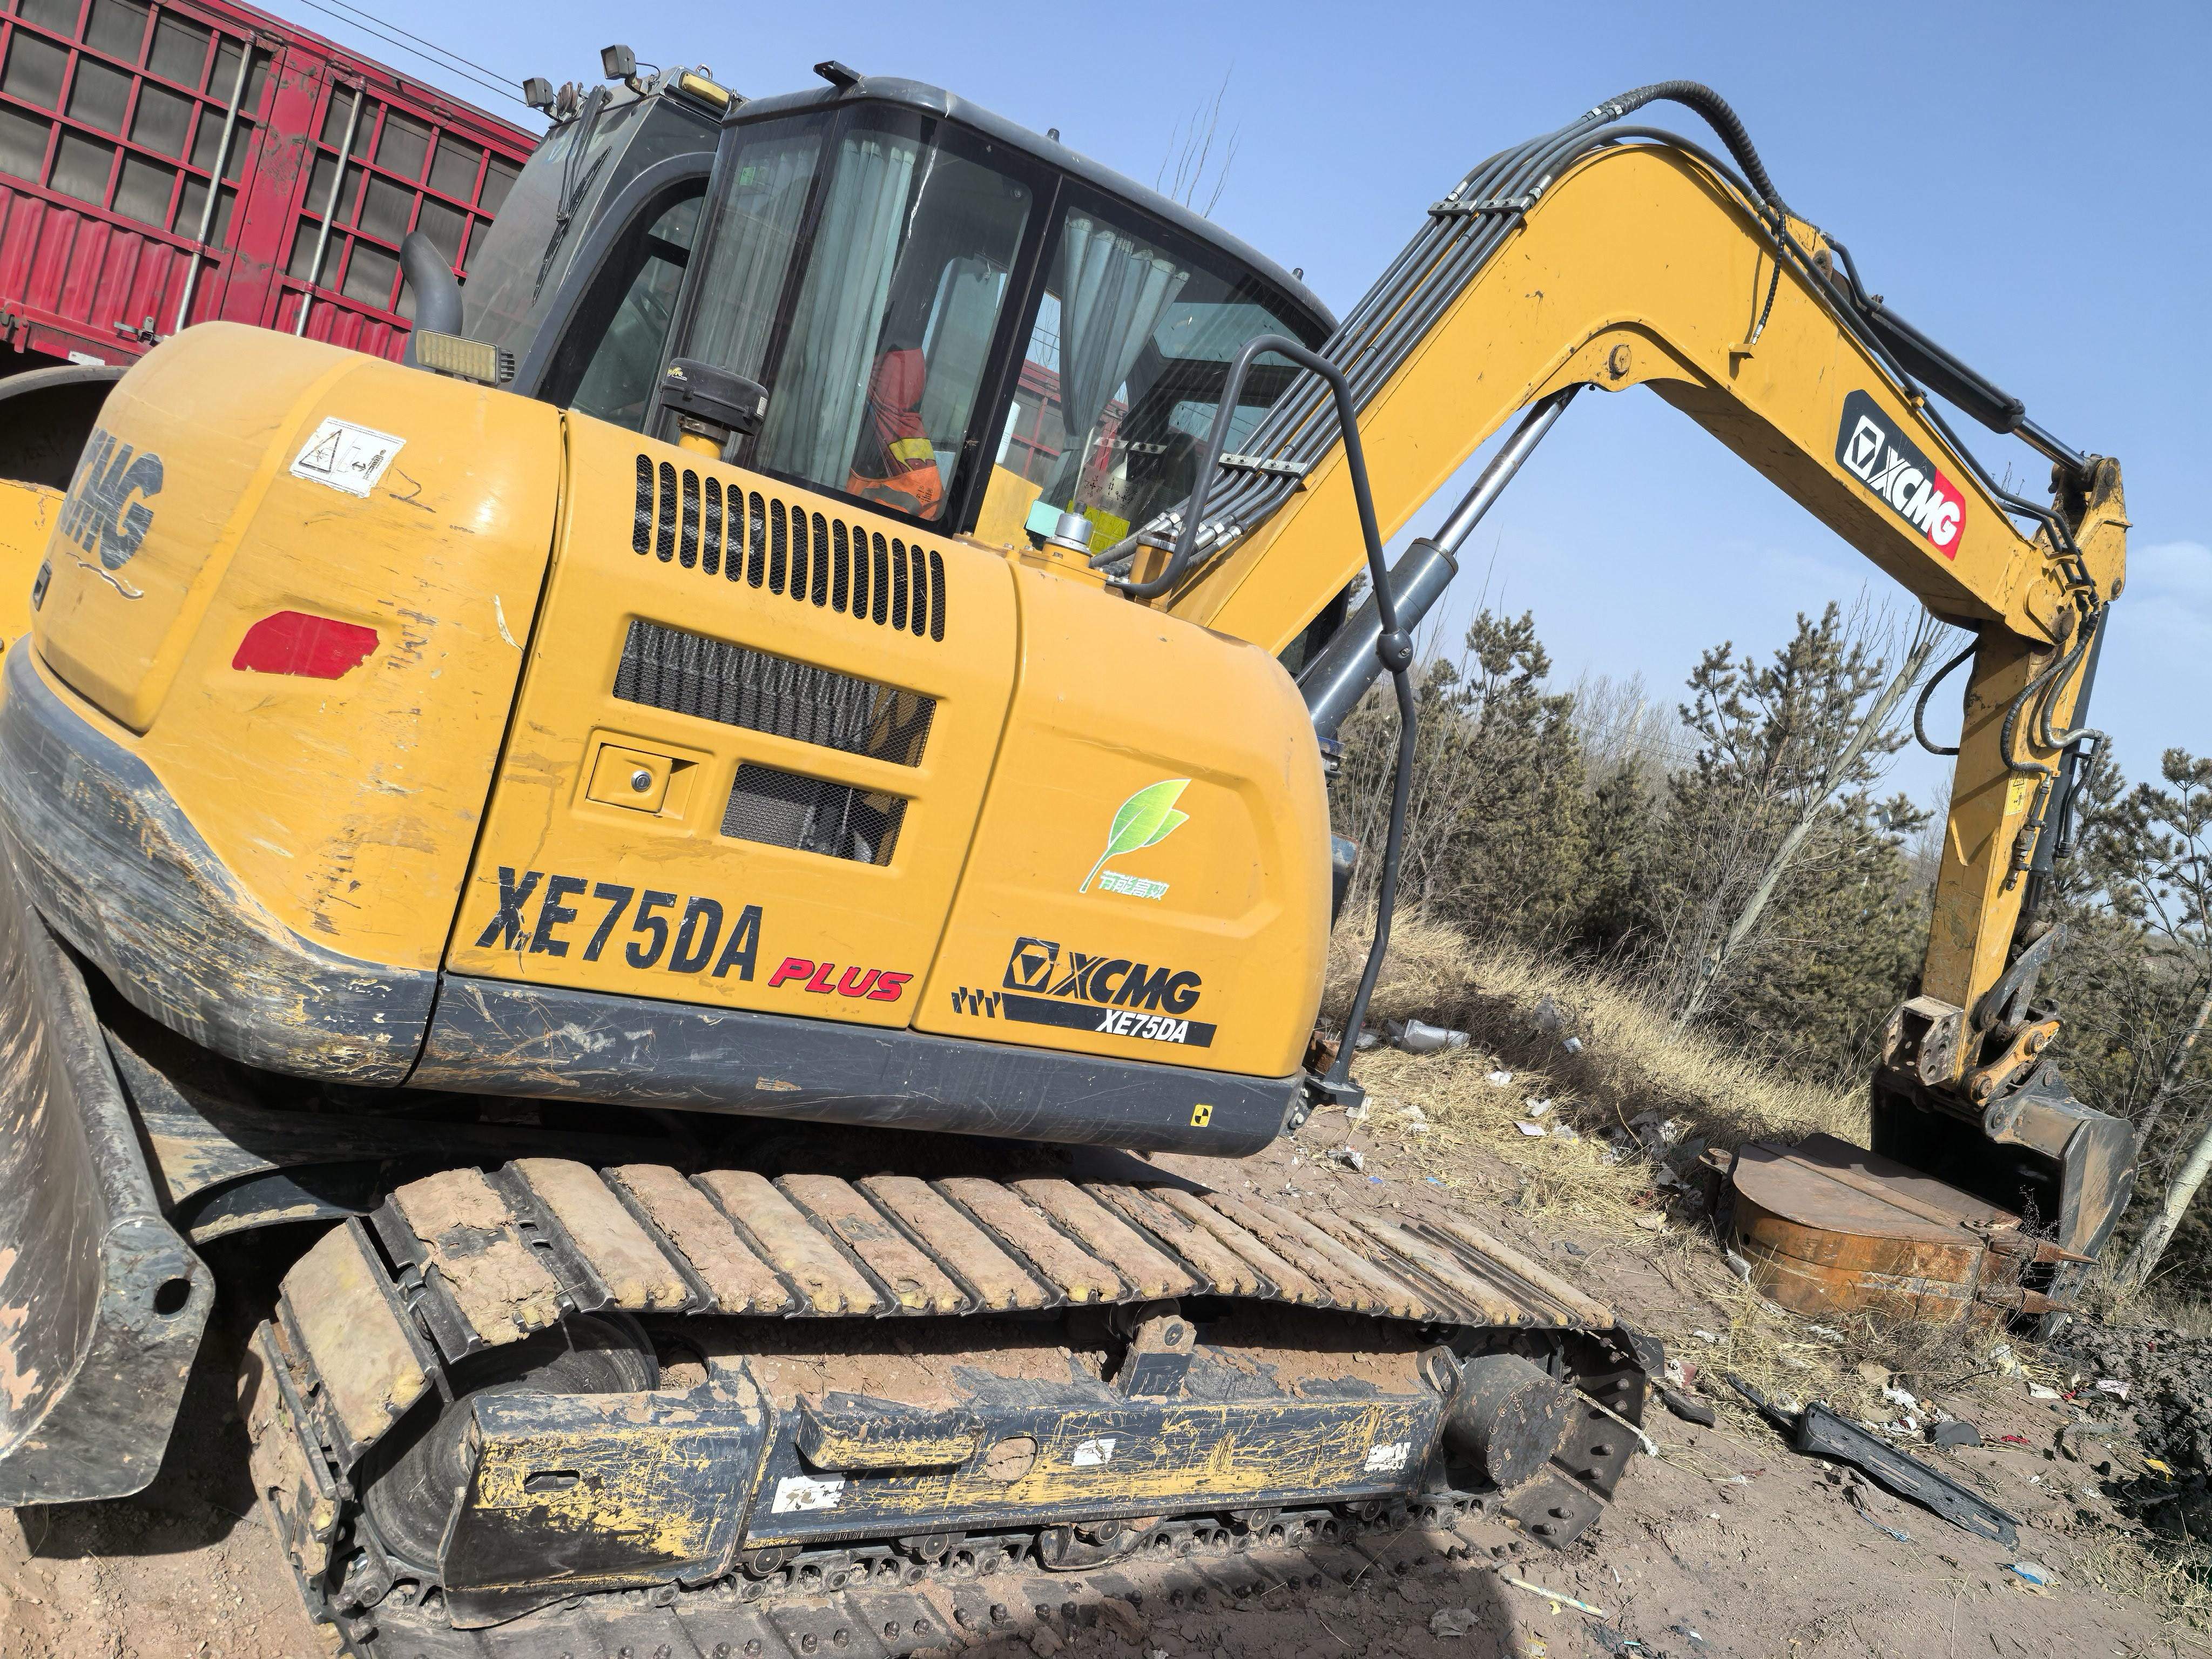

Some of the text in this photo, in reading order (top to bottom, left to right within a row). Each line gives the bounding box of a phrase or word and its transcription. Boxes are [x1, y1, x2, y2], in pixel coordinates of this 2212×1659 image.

[1866, 446, 1960, 545] XCMG
[1098, 870, 1170, 901] 节能高效
[475, 866, 914, 1002] XE75DA PLUS
[1046, 952, 1202, 1015] XCMG
[1095, 1009, 1189, 1044] XE75DA
